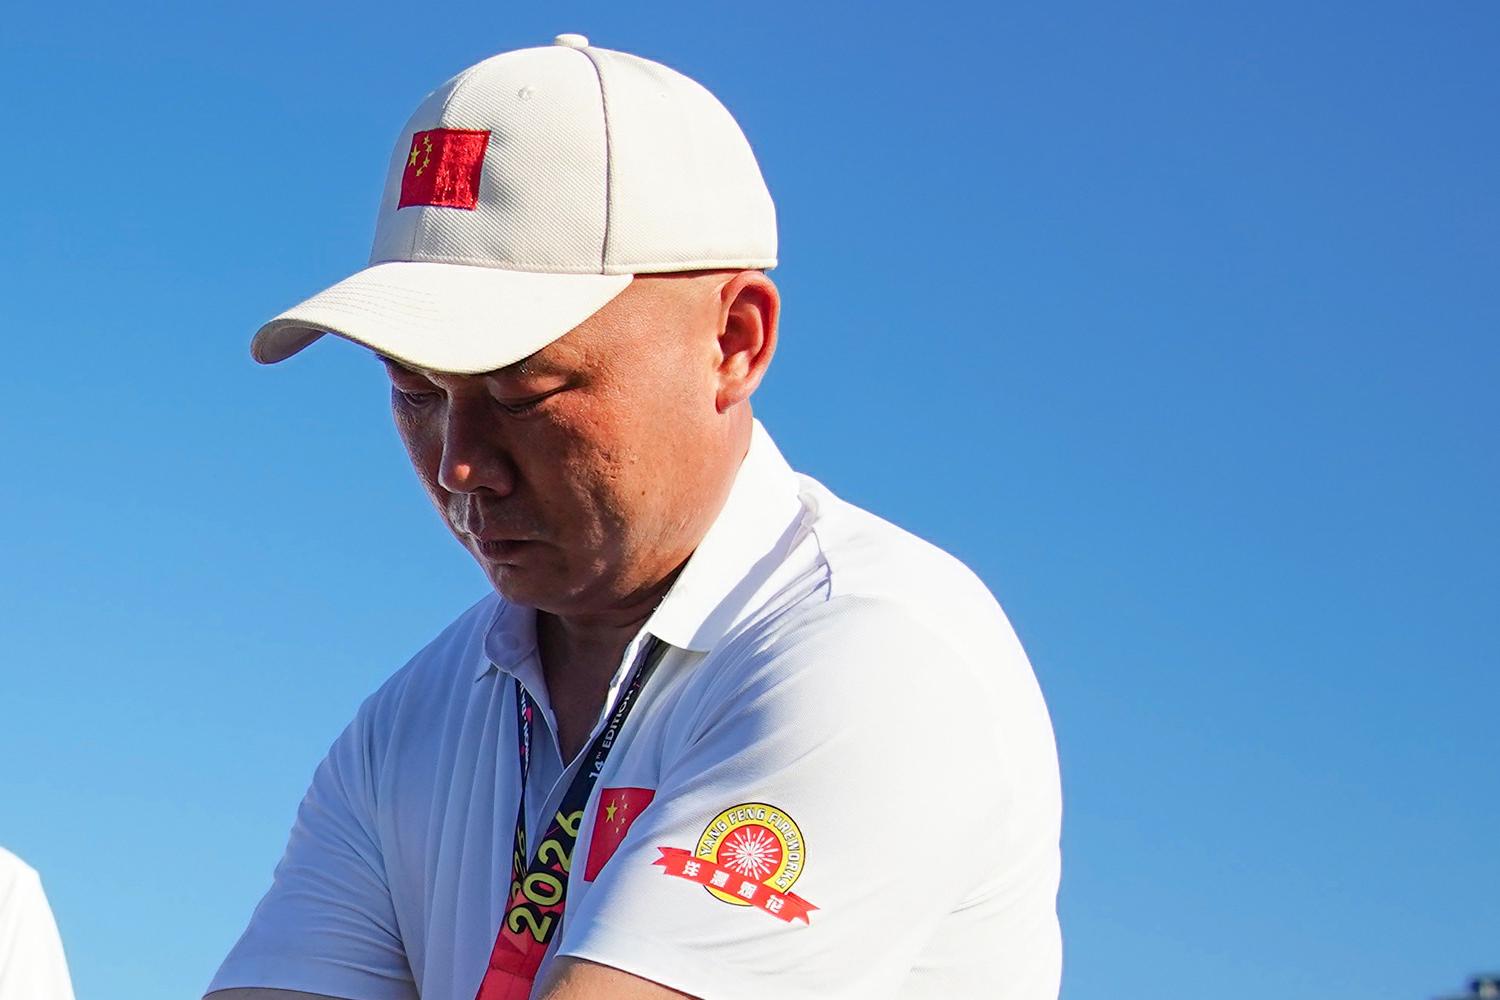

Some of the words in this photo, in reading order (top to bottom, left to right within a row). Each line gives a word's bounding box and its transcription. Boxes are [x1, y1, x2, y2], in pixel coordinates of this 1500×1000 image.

[602, 689, 634, 748] EDITION
[508, 810, 584, 943] 2026
[699, 821, 728, 857] YANG
[728, 807, 765, 824] FENG
[767, 811, 801, 889] FIREWORKS
